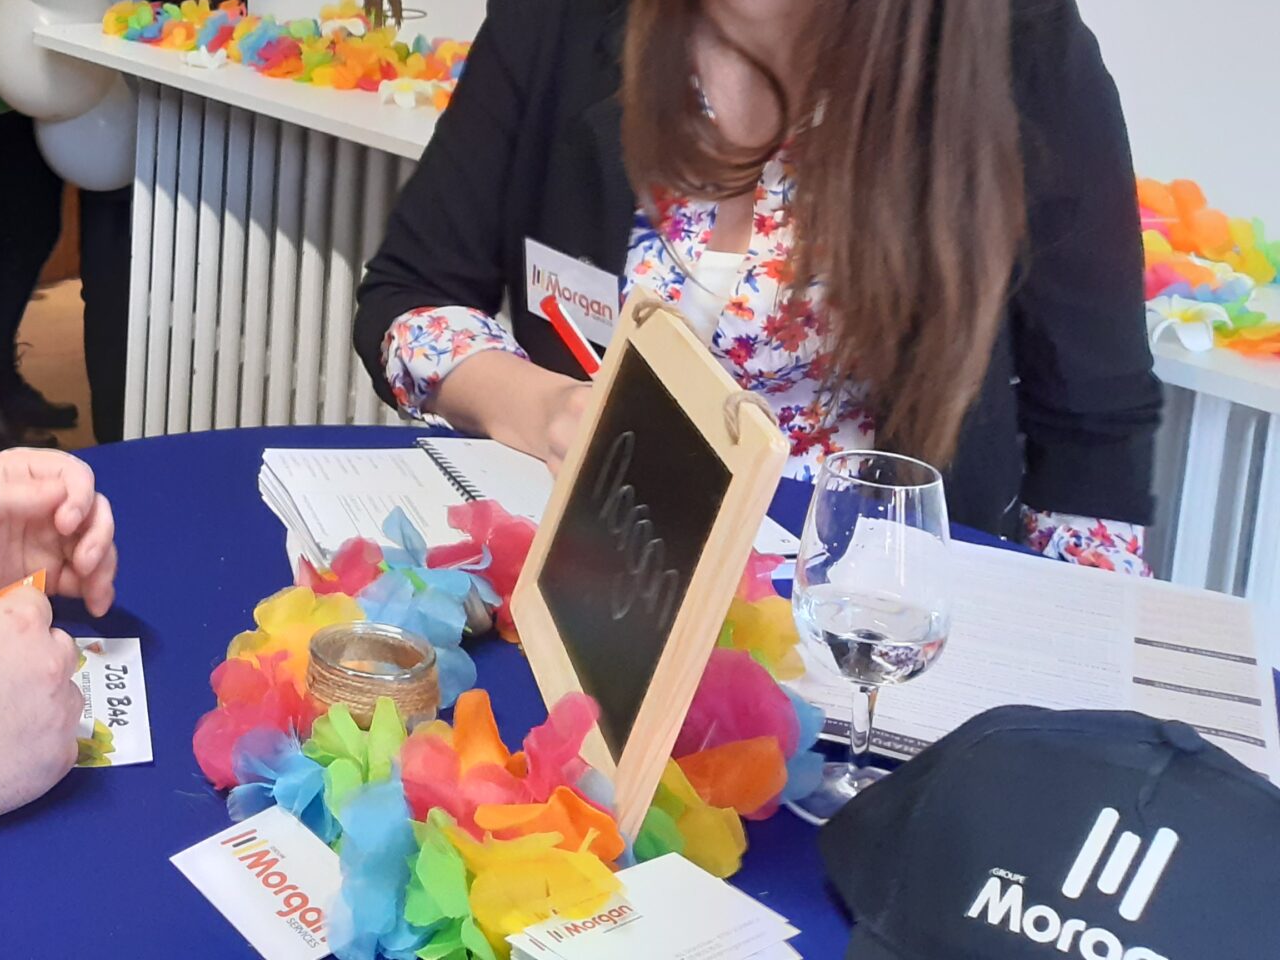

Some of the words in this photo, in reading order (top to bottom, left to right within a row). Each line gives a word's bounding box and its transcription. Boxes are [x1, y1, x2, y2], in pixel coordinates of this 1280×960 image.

[546, 275, 613, 321] Morgan
[104, 664, 129, 690] JOB
[106, 696, 132, 728] BAR
[991, 867, 1027, 884] GROUPE
[286, 917, 320, 948] SERVICES
[564, 904, 634, 937] Morgan
